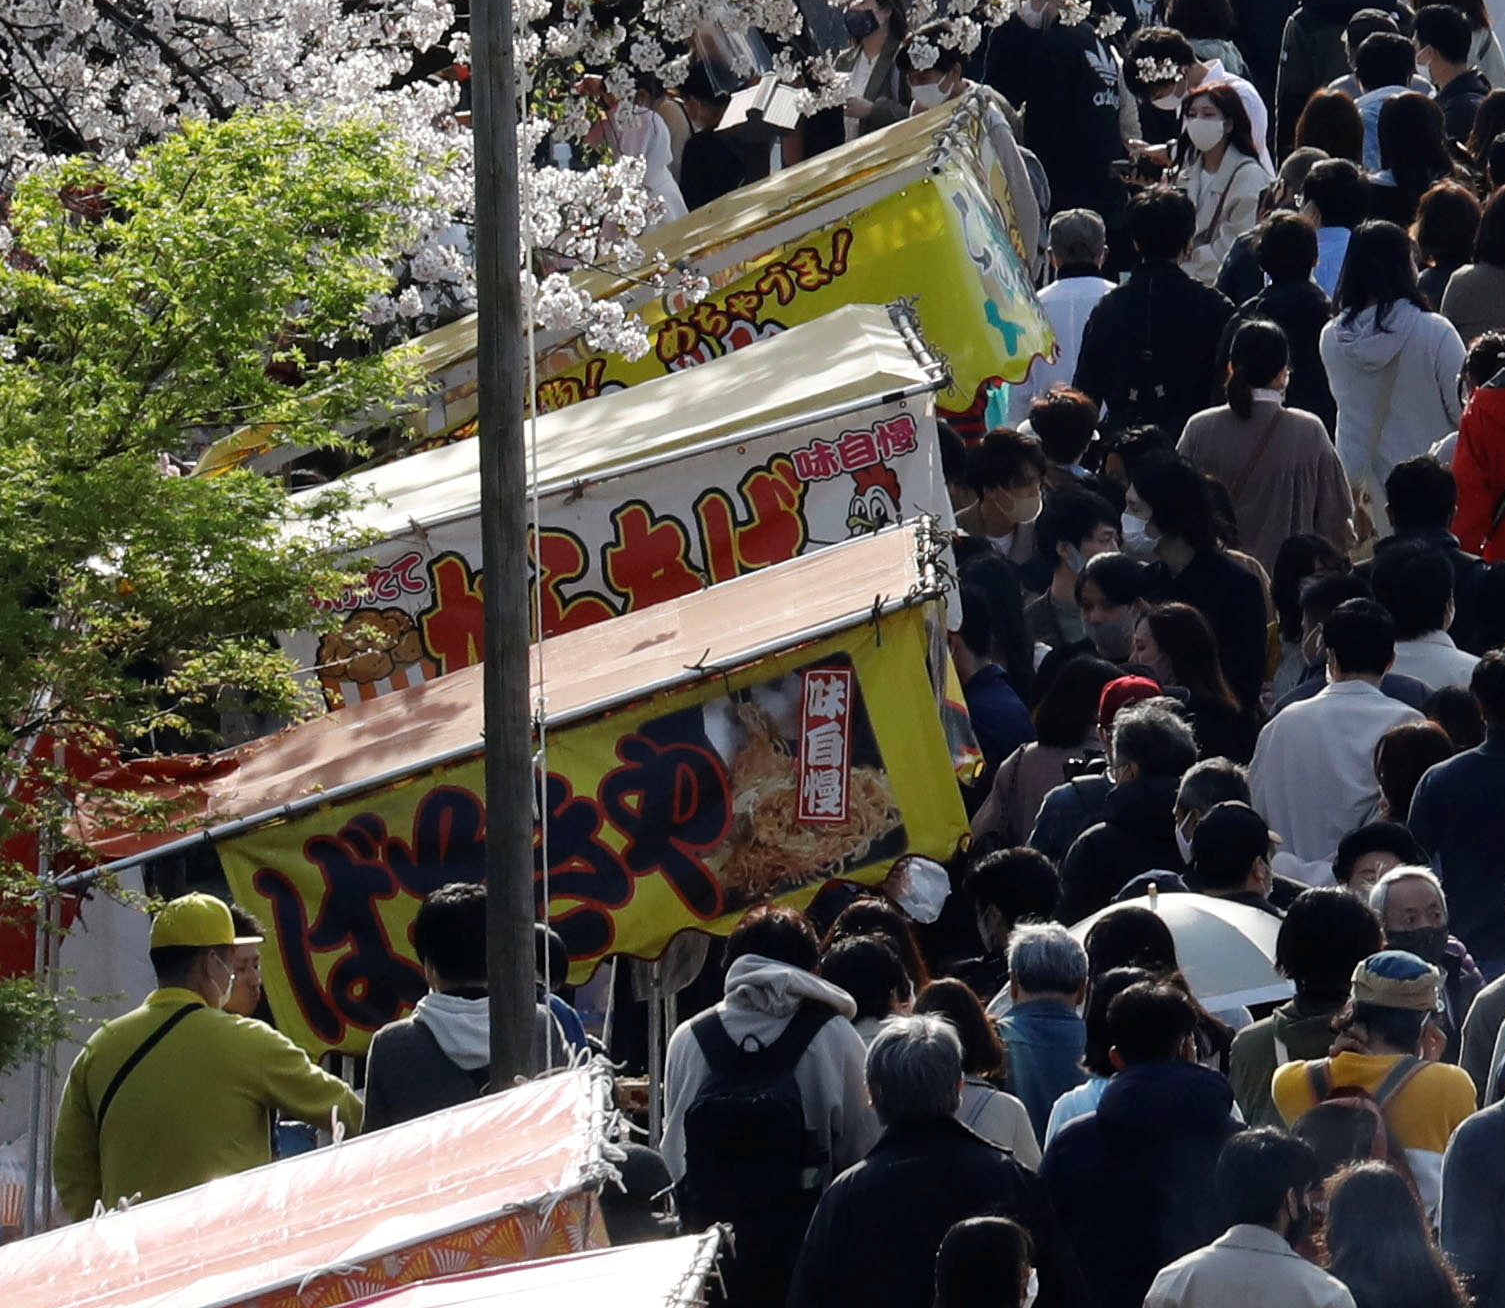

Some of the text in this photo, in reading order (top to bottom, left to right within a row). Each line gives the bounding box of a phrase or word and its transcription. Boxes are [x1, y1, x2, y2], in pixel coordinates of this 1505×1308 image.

[792, 416, 917, 482] 味自慢
[799, 668, 850, 821] 味自慢
